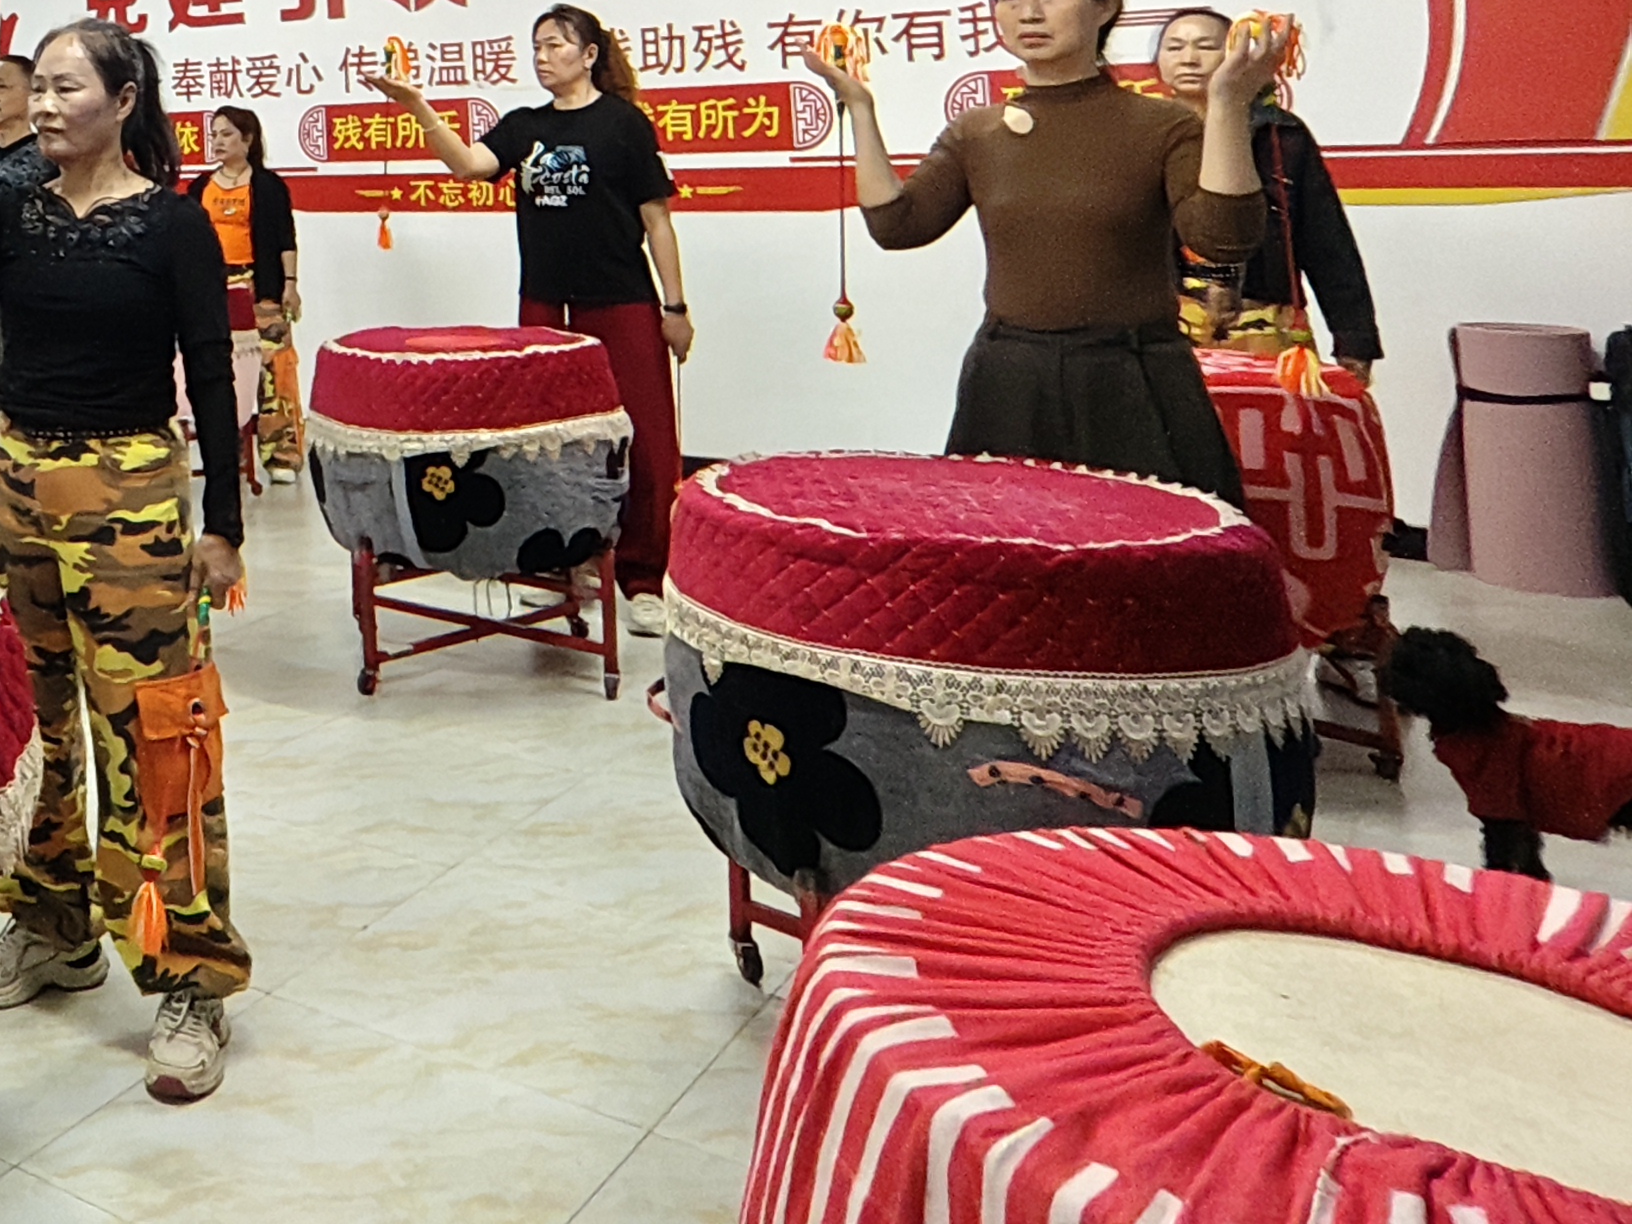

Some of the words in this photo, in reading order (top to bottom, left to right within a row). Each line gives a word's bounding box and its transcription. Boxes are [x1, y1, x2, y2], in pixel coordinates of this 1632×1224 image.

[171, 52, 324, 102] 奉献爱心
[637, 94, 780, 142] 有所为
[409, 179, 516, 208] 不忘初心
